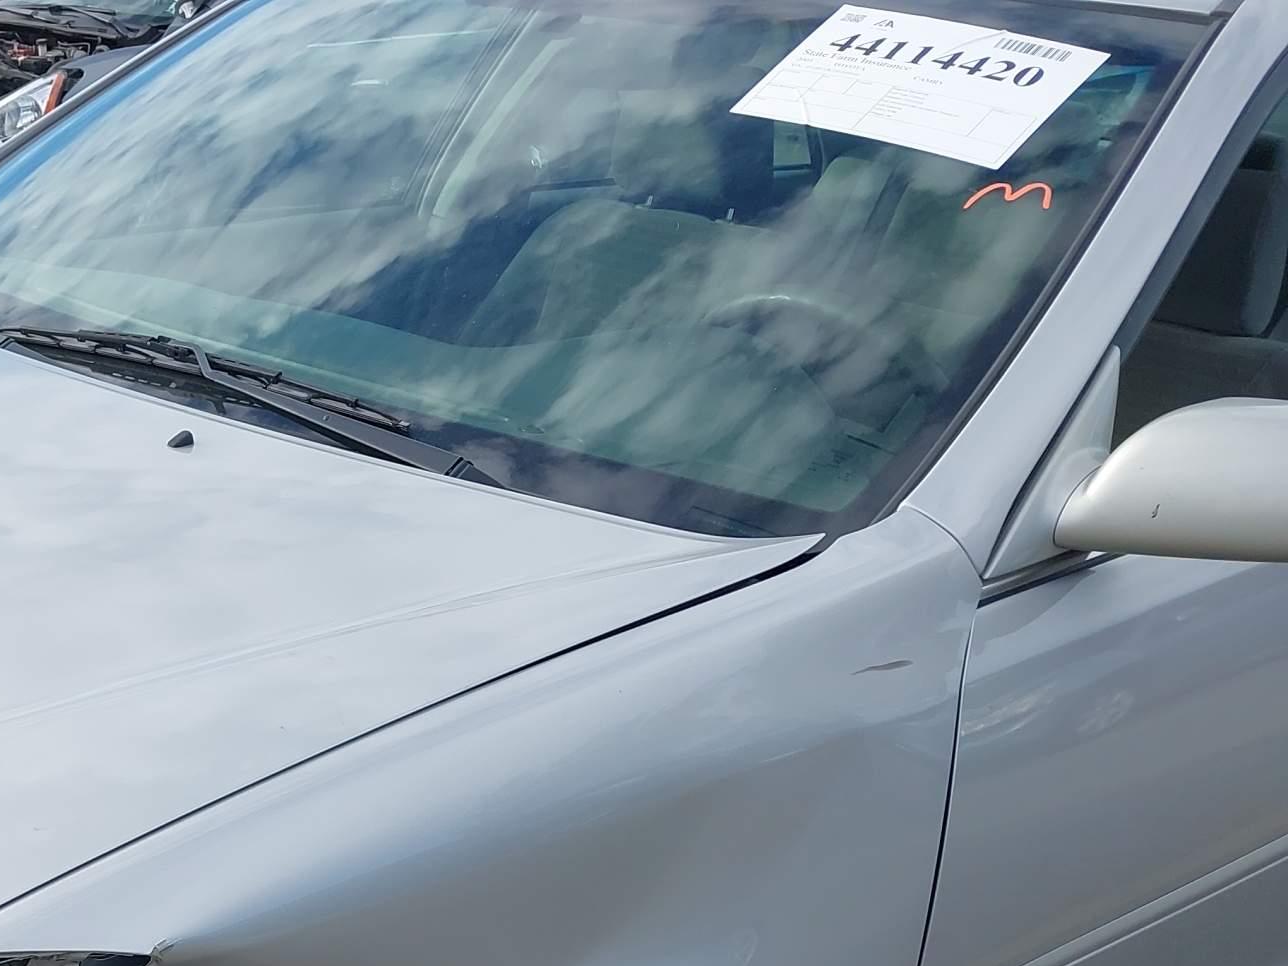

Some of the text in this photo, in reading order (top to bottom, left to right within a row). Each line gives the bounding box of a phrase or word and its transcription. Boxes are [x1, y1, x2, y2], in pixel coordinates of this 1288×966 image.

[803, 47, 829, 59] State
[829, 52, 858, 63] Farm
[861, 57, 913, 71] Insurance
[830, 33, 1045, 88] 44114420
